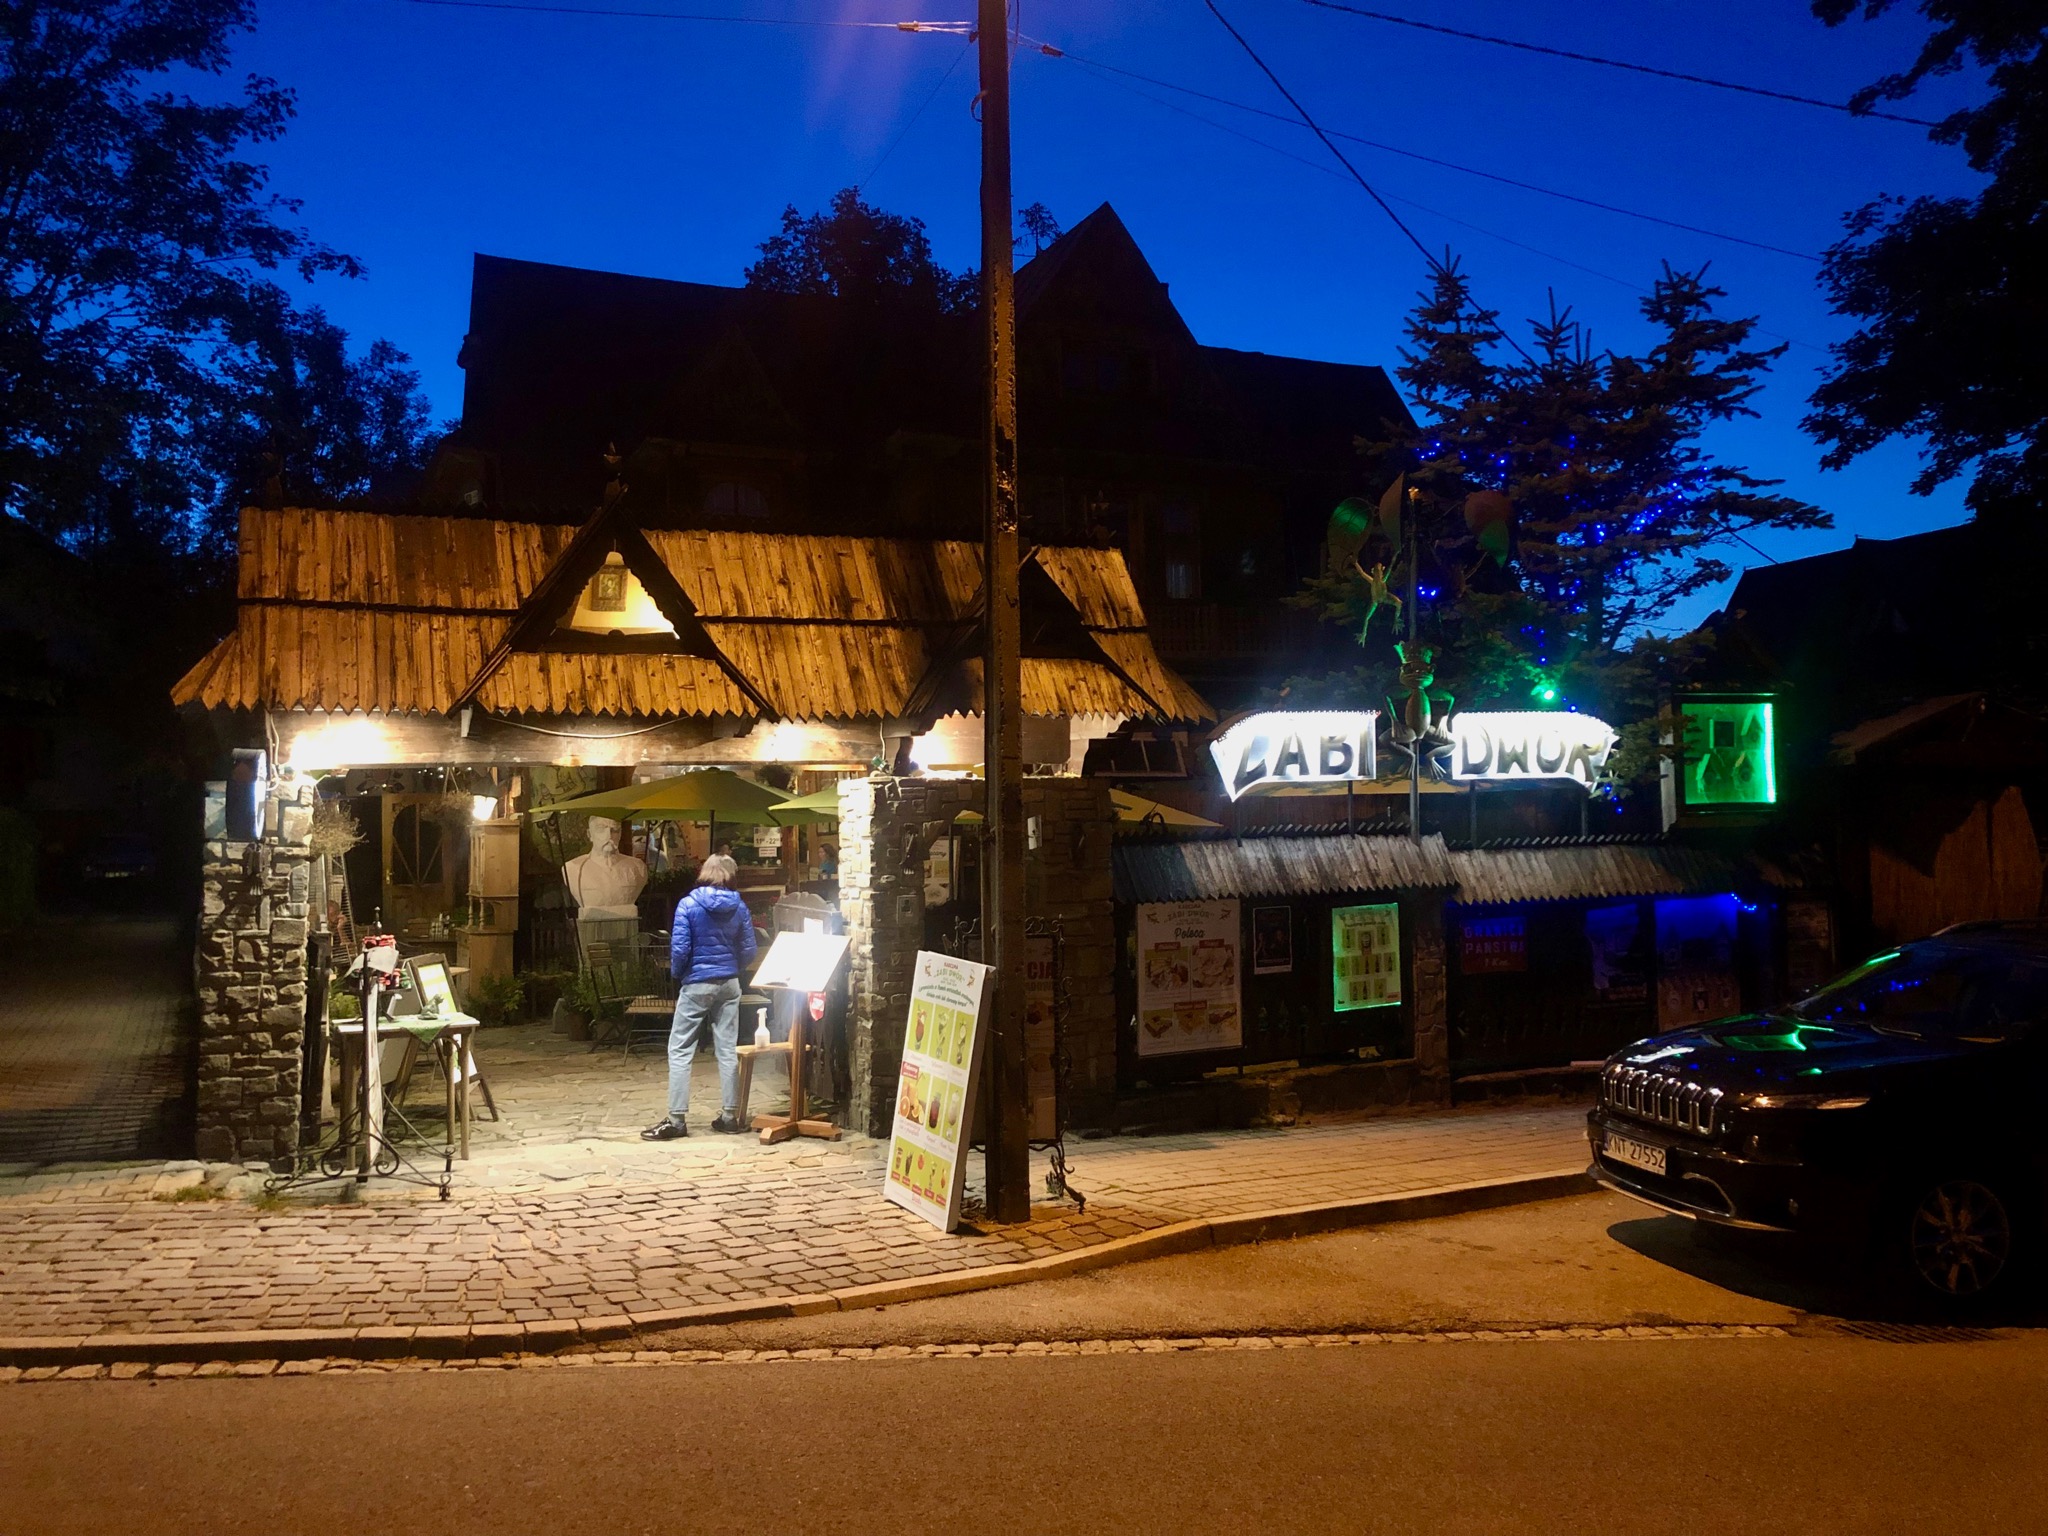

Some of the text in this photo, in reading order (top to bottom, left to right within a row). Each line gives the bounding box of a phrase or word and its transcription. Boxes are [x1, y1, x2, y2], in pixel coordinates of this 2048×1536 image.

[1174, 927, 1206, 940] Poleca
[1609, 1134, 1665, 1169] KNT 27552
